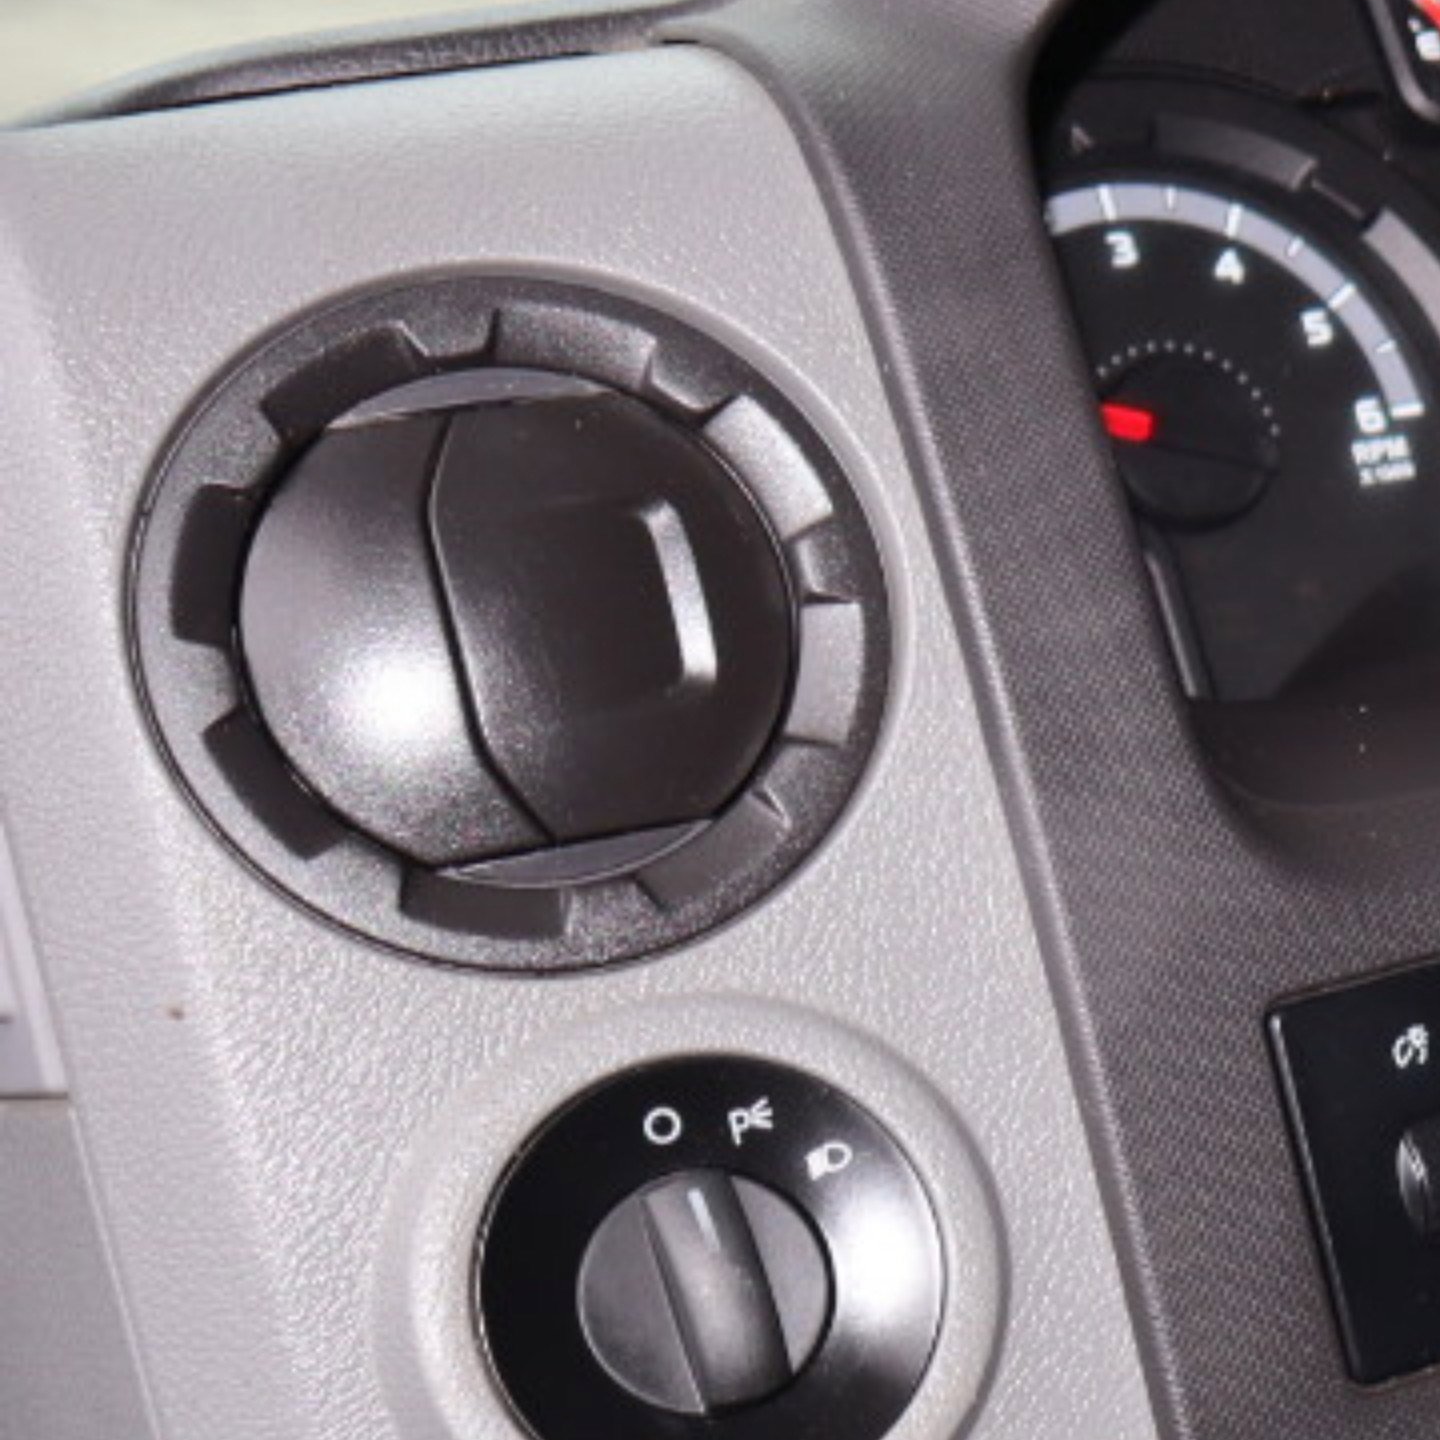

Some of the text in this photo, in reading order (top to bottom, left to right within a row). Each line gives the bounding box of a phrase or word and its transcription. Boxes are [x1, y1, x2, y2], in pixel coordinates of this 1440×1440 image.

[1105, 230, 1141, 269] 3
[1213, 247, 1246, 285] 4
[1301, 307, 1334, 349] 5
[1354, 396, 1387, 434] 6
[1350, 435, 1410, 466] RPM
